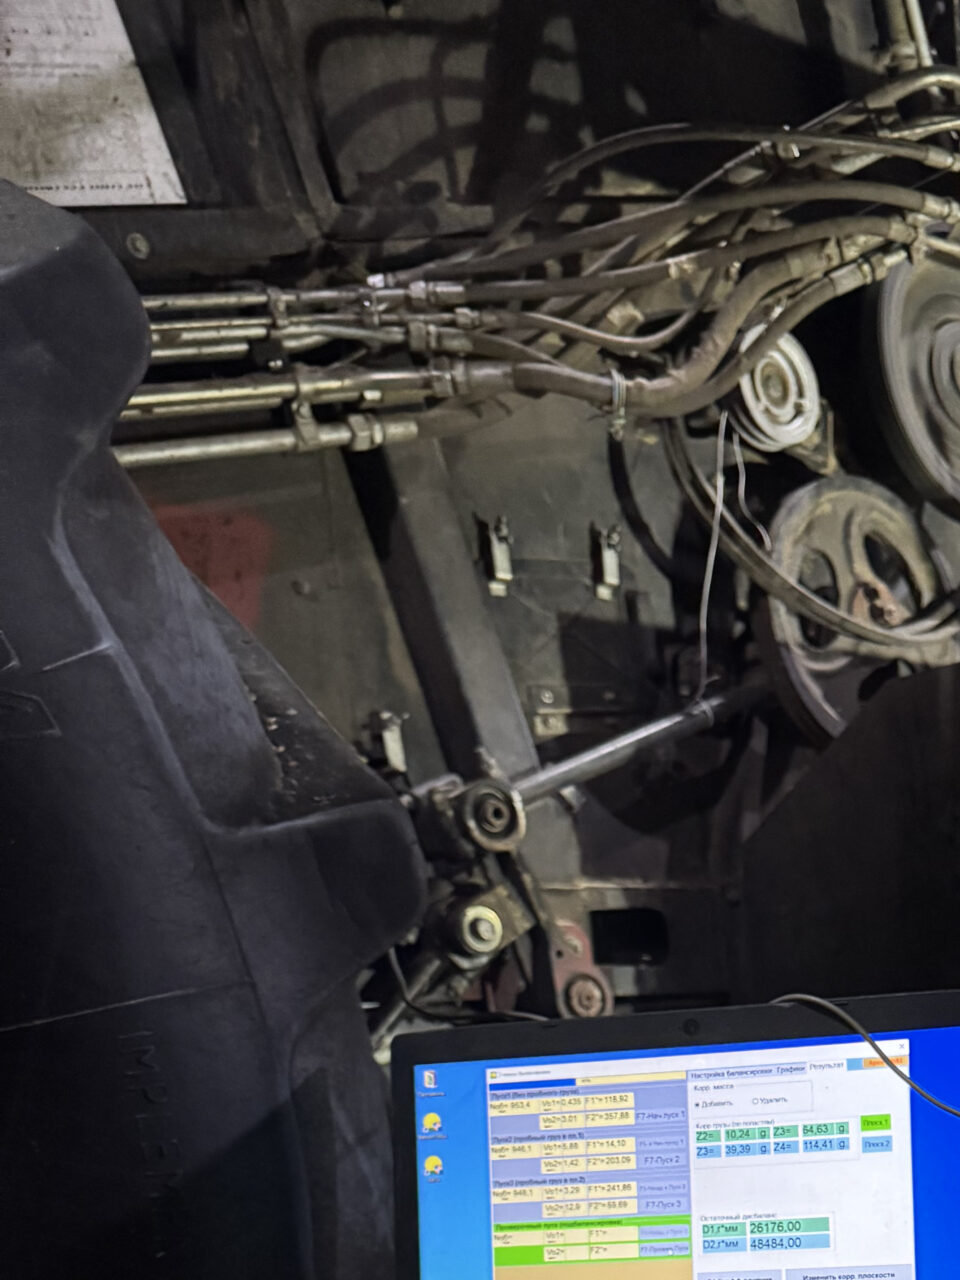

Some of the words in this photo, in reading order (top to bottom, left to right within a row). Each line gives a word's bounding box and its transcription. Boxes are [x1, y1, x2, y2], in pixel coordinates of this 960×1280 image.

[725, 1129, 751, 1140] 10,24
[802, 1124, 829, 1135] 64,63
[725, 1145, 751, 1156] 39,39
[803, 1140, 833, 1151] 114,41
[750, 1220, 801, 1233] 26176,00
[750, 1236, 802, 1250] 48484,00
[858, 1271, 896, 1280] плоскости
